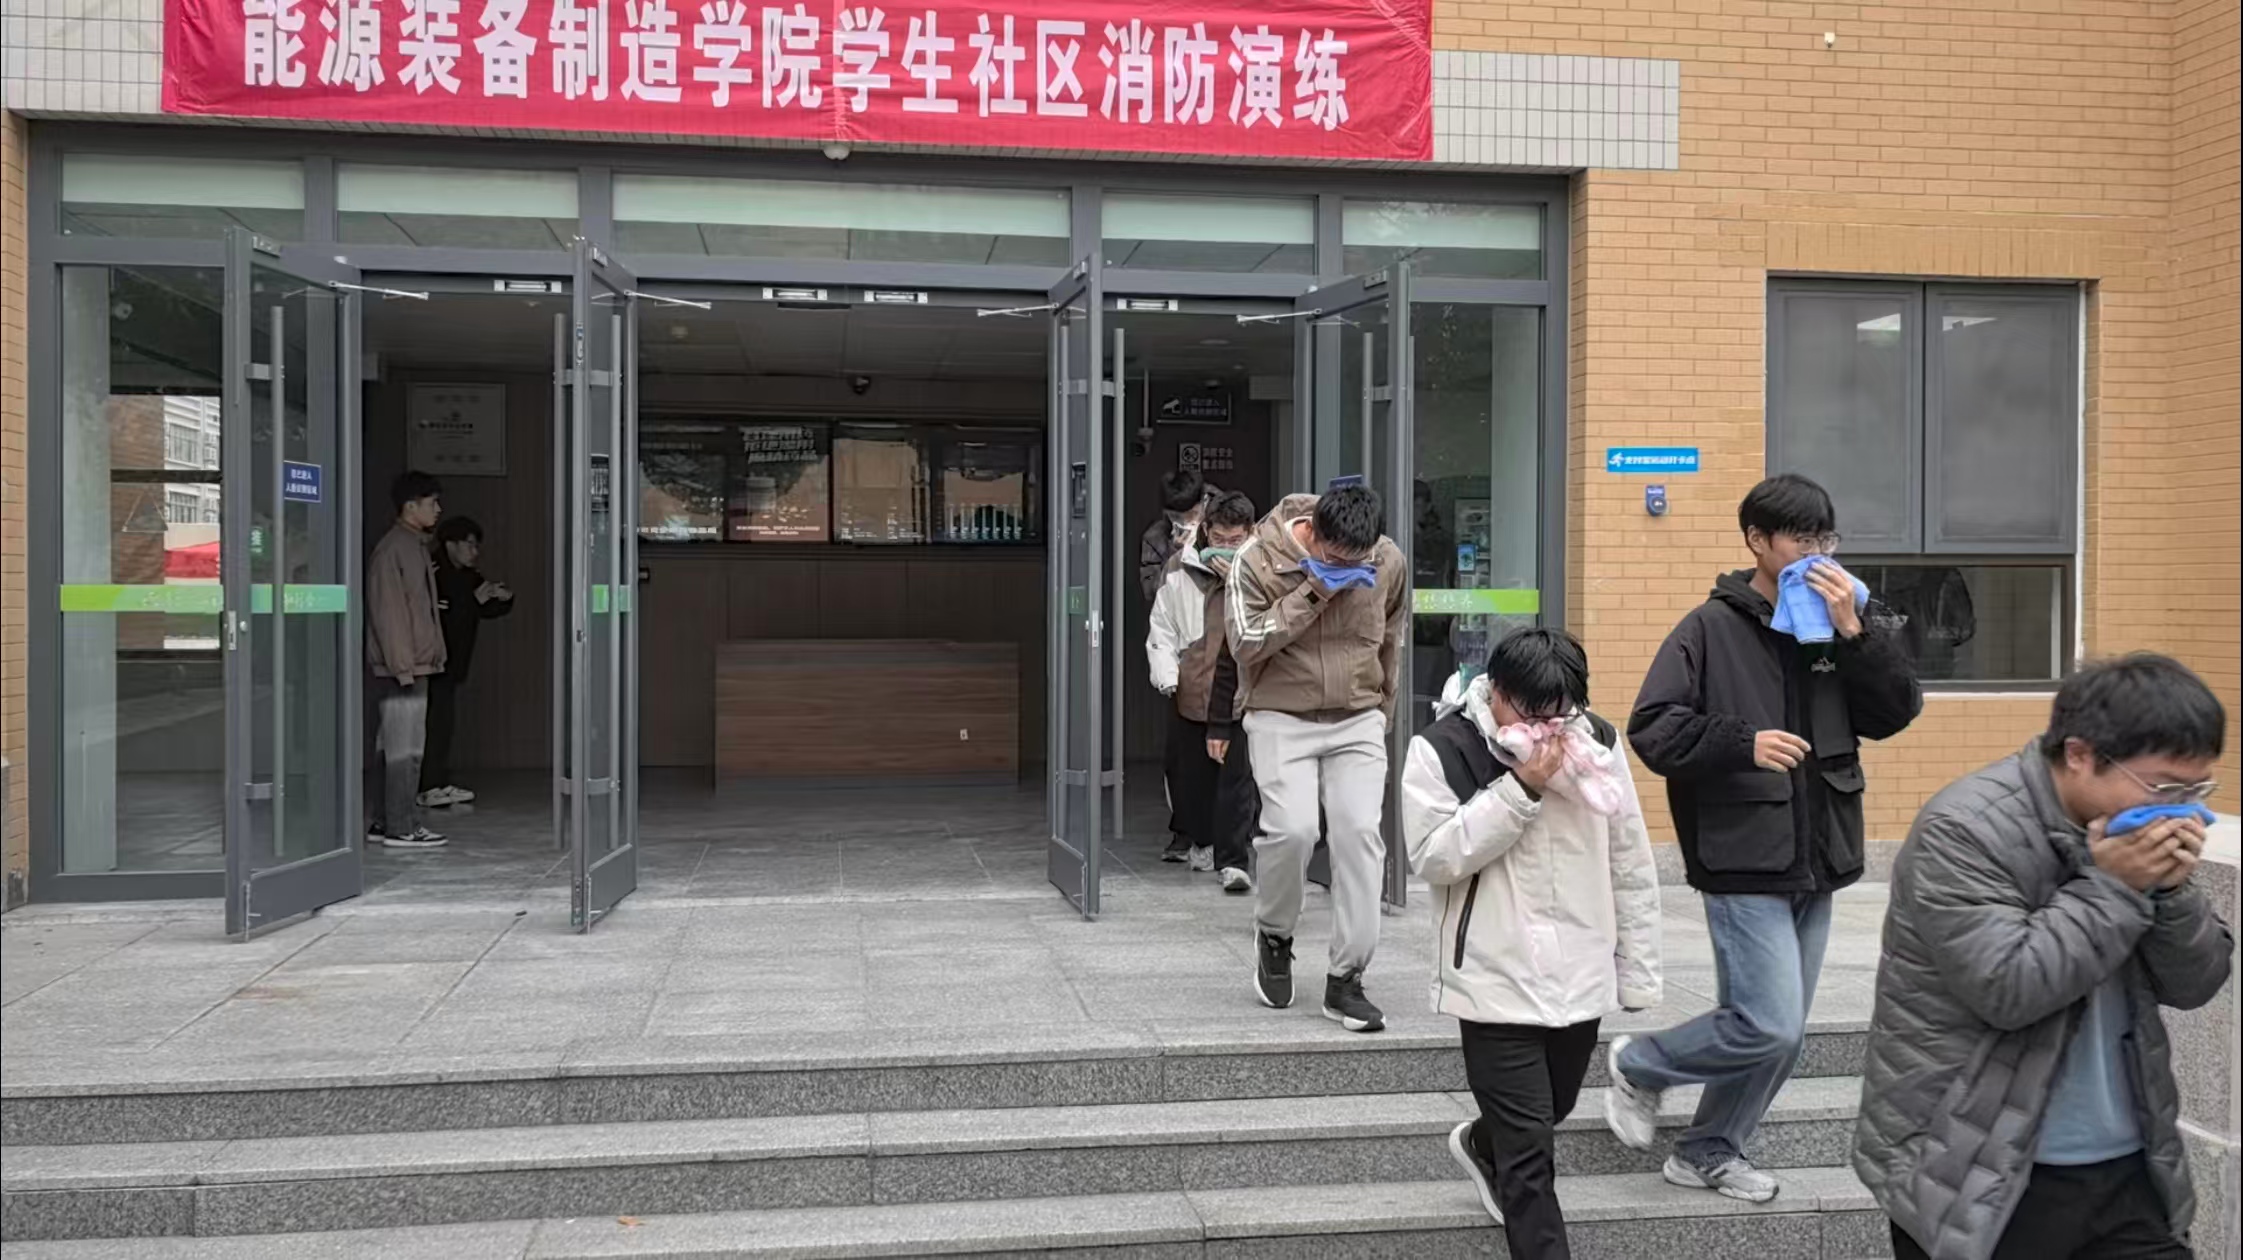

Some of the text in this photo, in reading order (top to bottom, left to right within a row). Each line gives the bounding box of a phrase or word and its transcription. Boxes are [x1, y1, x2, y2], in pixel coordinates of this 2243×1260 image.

[243, 0, 1351, 131] 能源装备制造学院学生社区消防演练
